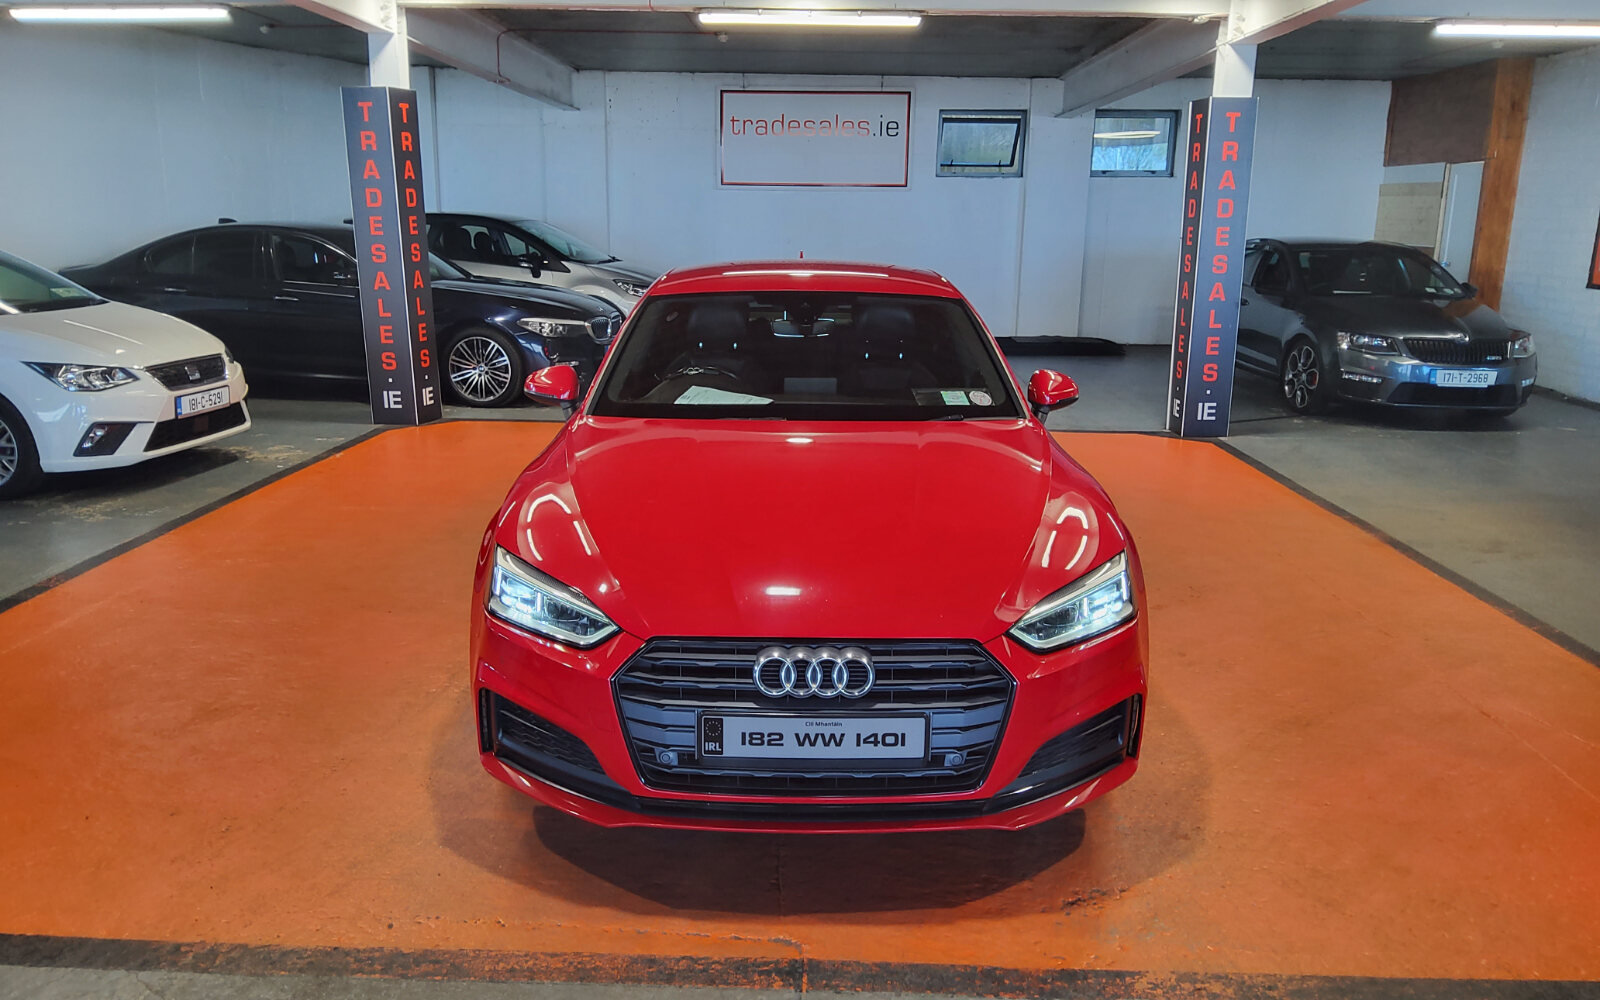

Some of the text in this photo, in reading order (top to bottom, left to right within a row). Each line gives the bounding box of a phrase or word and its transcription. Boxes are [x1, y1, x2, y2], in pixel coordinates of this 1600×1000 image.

[730, 114, 899, 137] tradesales.ie
[1443, 372, 1489, 384] 171-T-2968
[188, 390, 224, 411] 181-C-5291
[705, 742, 721, 751] IRL
[741, 732, 906, 747] 182 WW 1401
